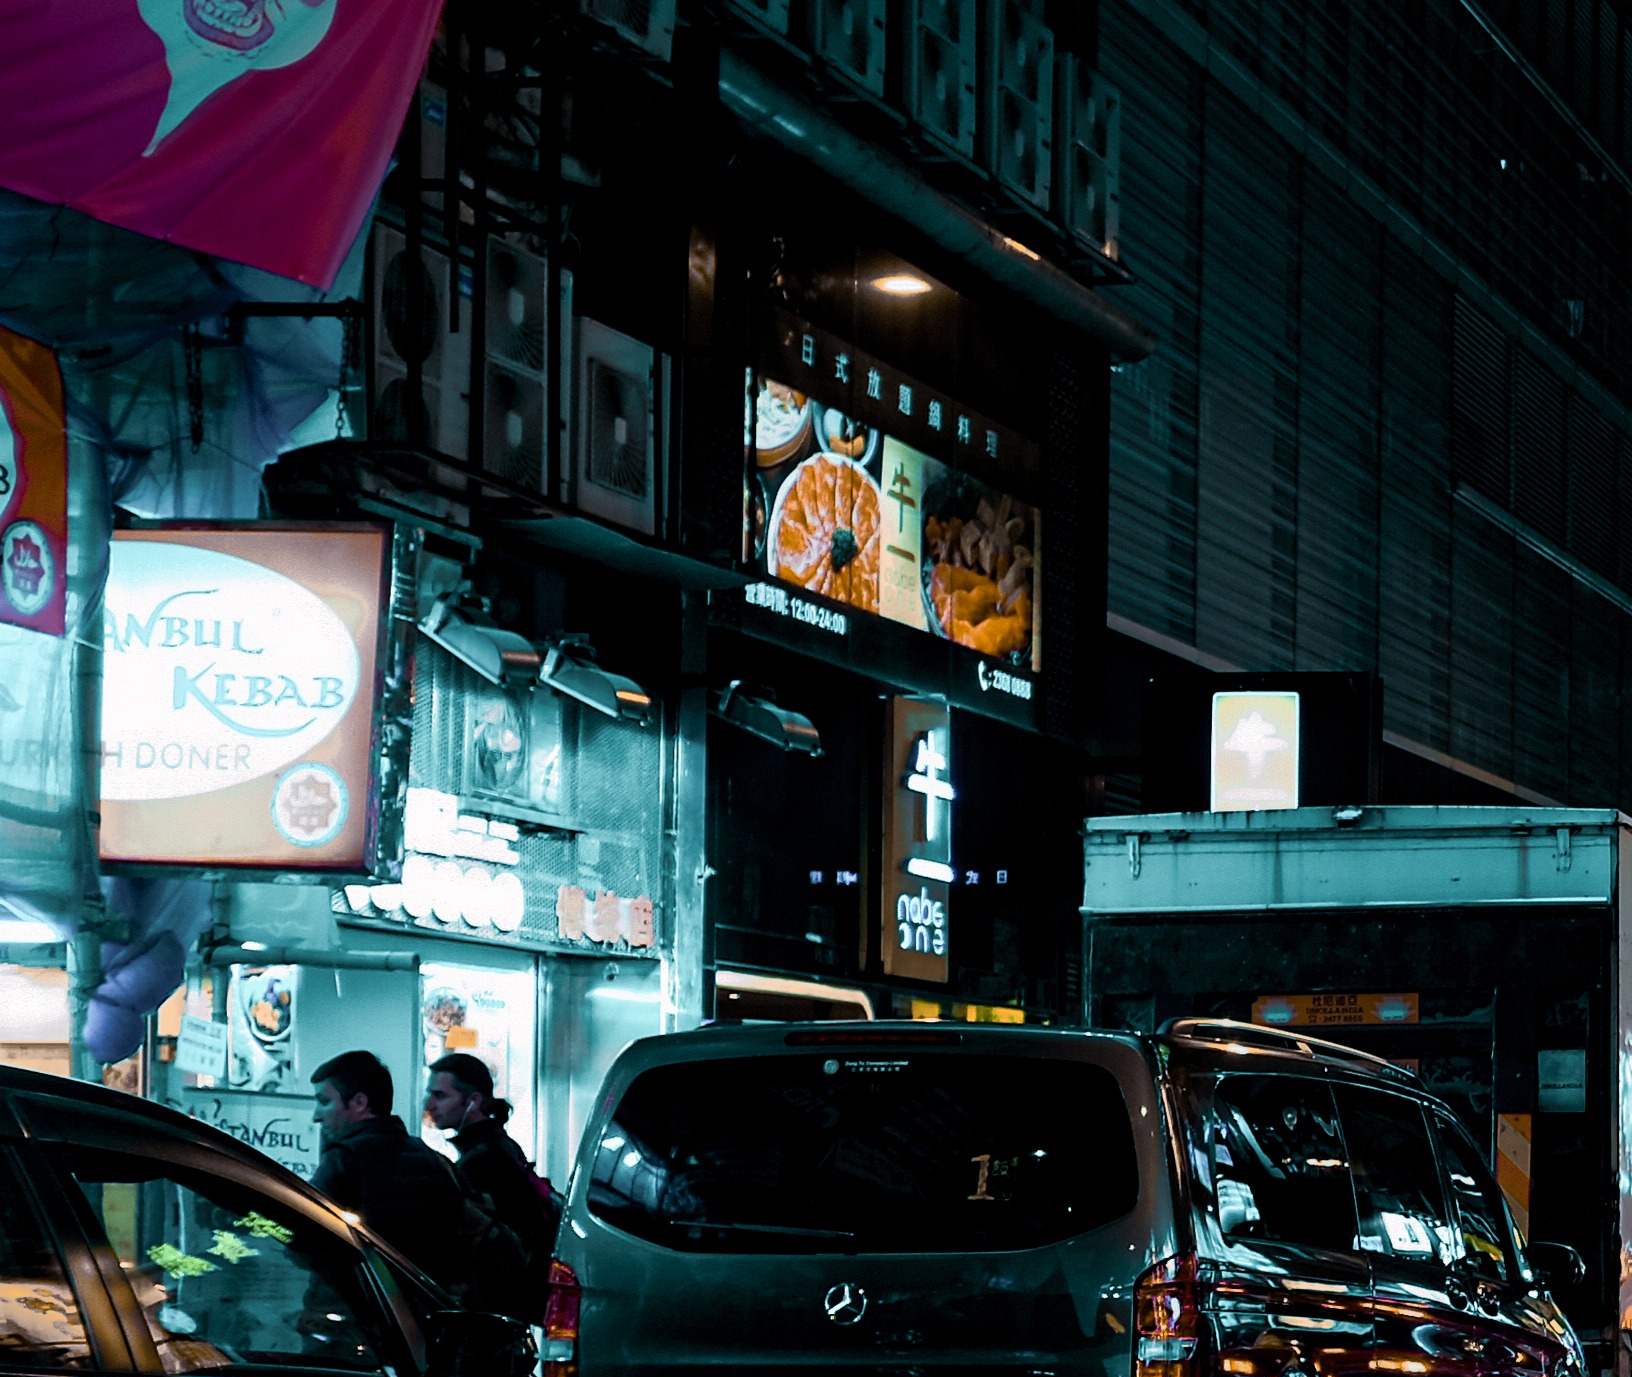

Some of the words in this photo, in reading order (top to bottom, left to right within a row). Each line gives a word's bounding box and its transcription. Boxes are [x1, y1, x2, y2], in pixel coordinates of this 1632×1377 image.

[886, 462, 916, 563] 牛一
[104, 588, 264, 655] ANBUL
[173, 661, 344, 738] KEBAB
[135, 741, 251, 771] DONER
[907, 729, 955, 883] 牛一
[897, 886, 944, 928] nabe
